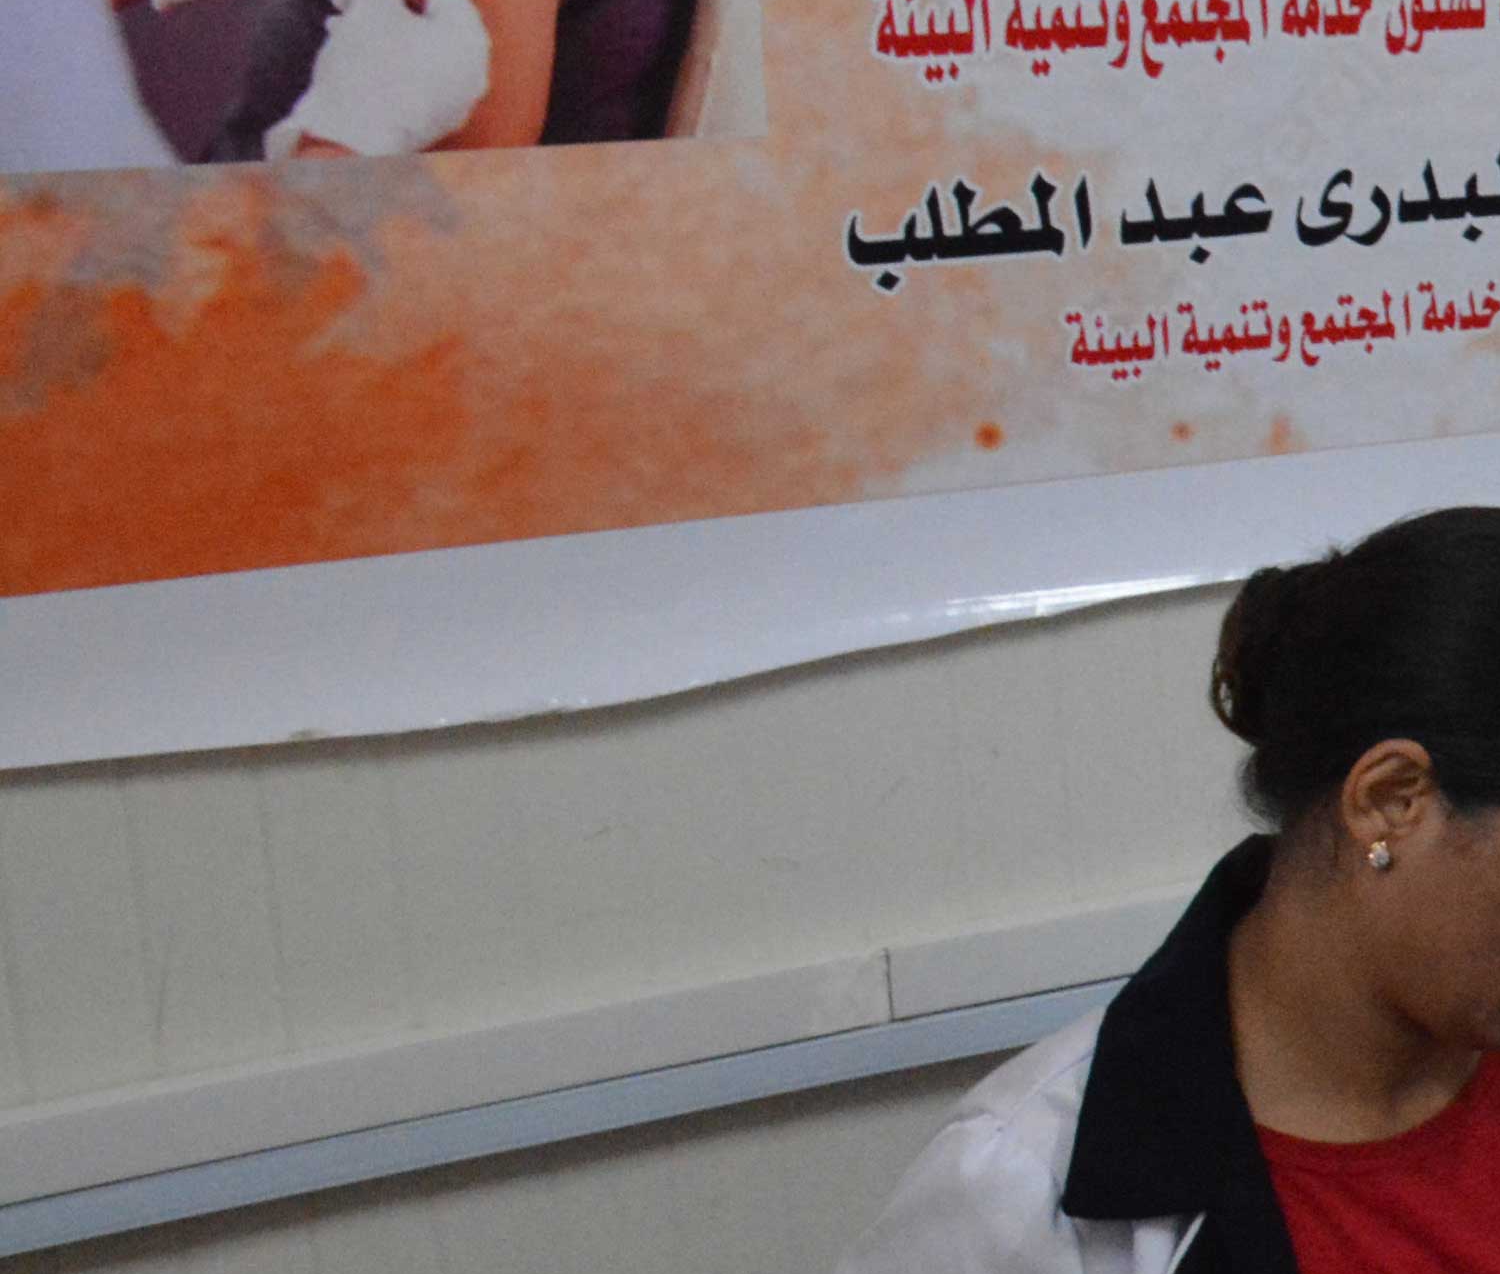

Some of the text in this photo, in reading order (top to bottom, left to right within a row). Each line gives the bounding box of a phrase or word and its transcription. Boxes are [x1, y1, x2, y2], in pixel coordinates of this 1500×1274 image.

[848, 175, 1091, 290] المطلب
[1121, 180, 1272, 263] عبد
[1066, 308, 1169, 379] البيئة
[1178, 301, 1291, 369] وتنمية
[1301, 291, 1411, 366] المجتمع
